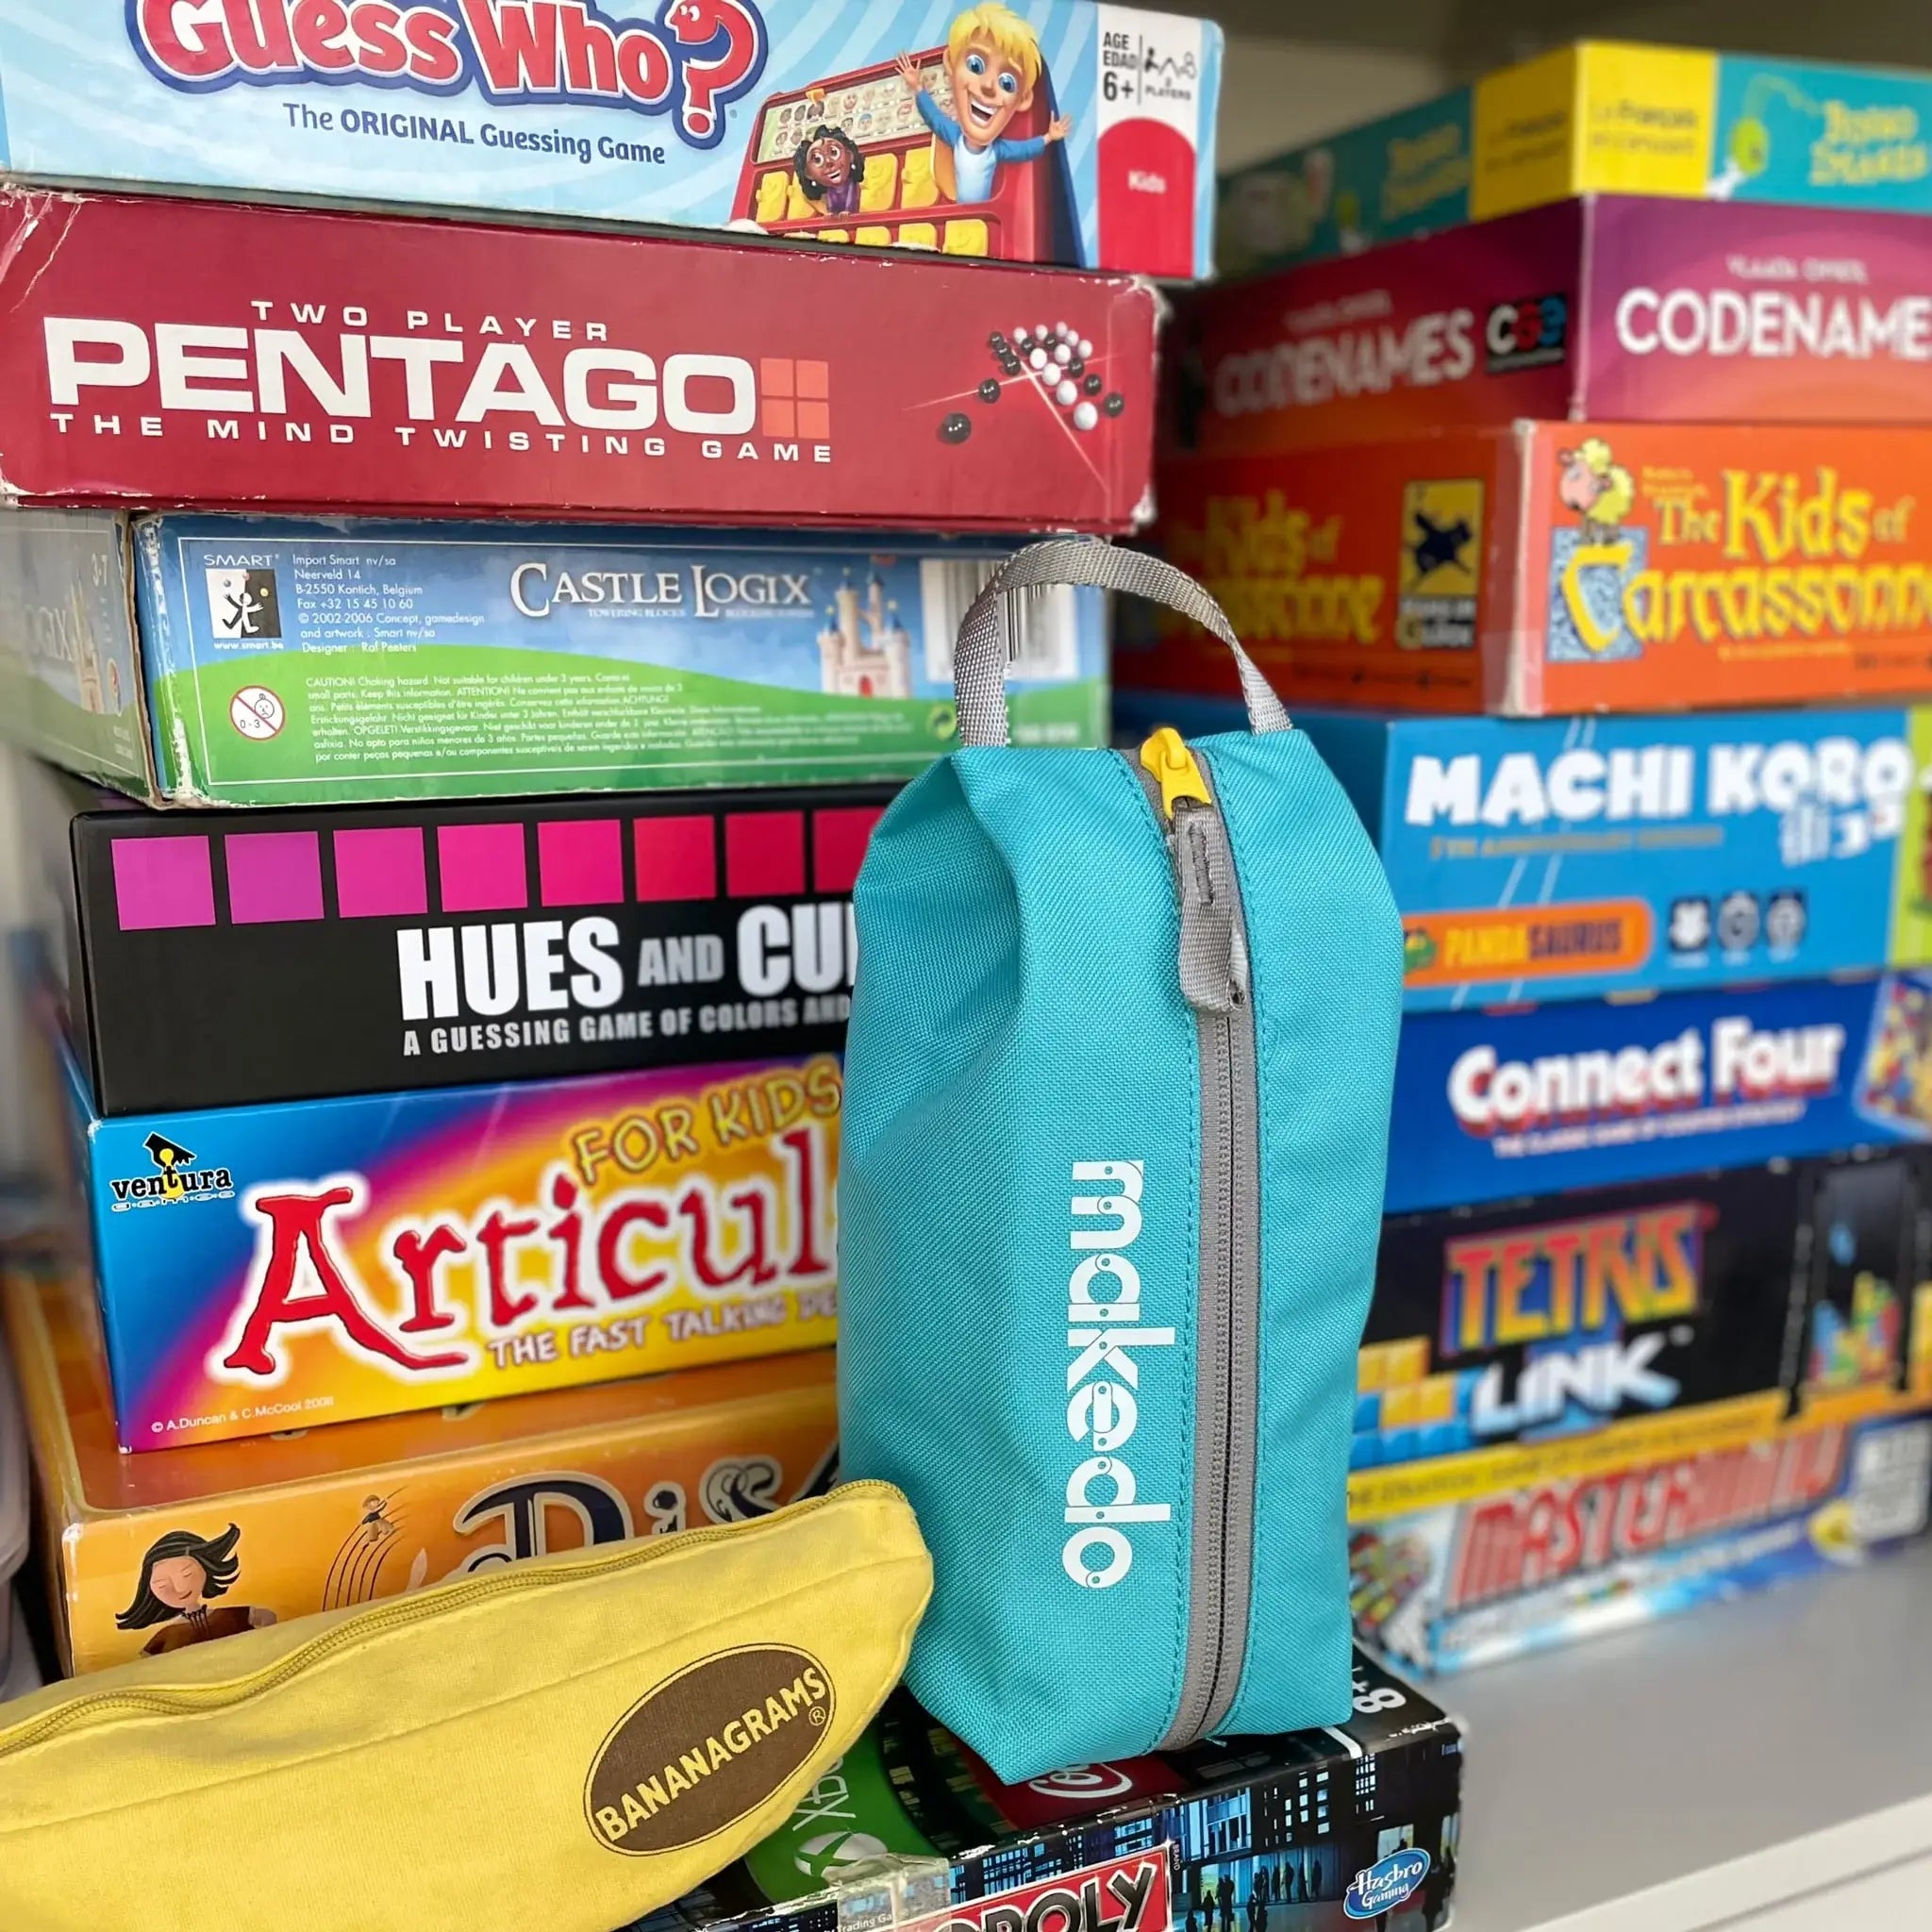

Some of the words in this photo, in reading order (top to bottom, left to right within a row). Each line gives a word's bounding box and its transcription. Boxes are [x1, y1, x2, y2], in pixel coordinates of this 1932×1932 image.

[135, 0, 462, 85] Guess
[1103, 32, 1130, 50] AGE
[1103, 50, 1139, 70] EDAD
[1103, 71, 1135, 102] 6+
[283, 103, 333, 130] The
[340, 109, 474, 145] ORIGINAL
[480, 123, 591, 164] Guessing
[598, 135, 665, 165] Game
[252, 300, 367, 328] TWO
[408, 309, 609, 342] PLAYER
[1616, 287, 1932, 360] CODENAME
[43, 316, 758, 436] PENTAGO
[50, 413, 163, 439] THE
[208, 418, 356, 445] MIND
[396, 426, 665, 457] TWISTING
[702, 439, 831, 463] GAME
[1722, 465, 1874, 561] Kids
[203, 554, 274, 567] SMART
[292, 554, 326, 568] Import
[329, 554, 359, 566] Smart
[366, 555, 396, 567] nv/sa
[294, 568, 343, 580] Neerveld
[347, 569, 361, 580] 14
[295, 583, 335, 594] B-2550
[338, 583, 379, 596] Kontich,
[382, 583, 423, 597] Belgium
[297, 598, 317, 609] Fax
[320, 597, 341, 609] +32
[346, 597, 359, 609] 15
[363, 597, 377, 609] 45
[383, 597, 396, 609] 10
[399, 597, 414, 609] 60
[509, 561, 683, 619] CASTLE
[690, 564, 812, 619] LOGIX
[1561, 543, 1932, 652] Carcassonn
[300, 626, 321, 639] and
[325, 626, 364, 639] artwork
[374, 626, 404, 639] Smart
[407, 626, 436, 639] nv/sa
[425, 611, 485, 626] gamedesign
[213, 641, 284, 650] www.smart.be
[302, 641, 347, 657] Designer
[361, 640, 378, 653] Raf
[381, 641, 417, 653] Peeters
[306, 676, 355, 687] CAUTION!
[358, 675, 395, 688] Choking
[434, 675, 450, 685] Not
[453, 674, 485, 685] suitable
[486, 675, 498, 684] for
[308, 690, 331, 700] small
[360, 689, 384, 700] Keep
[386, 689, 401, 699] this
[457, 686, 510, 696] ATTENTION!
[330, 702, 354, 711] Petits
[395, 699, 446, 711] susceptibles
[391, 712, 416, 723] Nicht
[470, 709, 498, 720] Kinder
[348, 739, 364, 748] No
[366, 739, 387, 749] apto
[388, 738, 409, 749] para
[411, 736, 435, 746] niños
[437, 734, 473, 744] menores
[474, 734, 485, 744] de
[521, 732, 546, 742] Partes
[353, 724, 398, 736] OPGELET!
[315, 752, 331, 763] por
[333, 750, 360, 760] conter
[363, 750, 391, 761] peças
[391, 749, 434, 761] pequenas
[435, 746, 458, 758] e/ou
[458, 746, 514, 758] componentes
[563, 742, 575, 753] de
[1404, 744, 1697, 826] MACHI
[1706, 736, 1916, 815] KORO
[396, 916, 625, 1022] HUES
[638, 934, 725, 988] AND
[403, 1030, 422, 1057] A
[431, 1018, 571, 1056] GUESSING
[580, 1010, 654, 1043] GAME
[660, 1007, 693, 1036] OF
[698, 997, 798, 1033] COLORS
[803, 994, 851, 1024] AND
[1447, 1024, 1704, 1127] Connect
[1711, 1017, 1846, 1097] Four
[574, 1107, 701, 1188] FOR
[709, 1061, 841, 1159] KIDS
[110, 1165, 234, 1200] ventura
[223, 1129, 834, 1374] Articul
[1447, 1208, 1697, 1350] TETRIS
[486, 1334, 557, 1370] THE
[570, 1321, 654, 1357] FAST
[666, 1300, 790, 1342] TALKING
[797, 1292, 839, 1322] DE
[1062, 1159, 1176, 1590] makedo
[1471, 1333, 1682, 1436] LINK
[166, 1413, 226, 1432] A.Duncan
[241, 1401, 303, 1420] C.McCool
[595, 1667, 826, 1842] BANANAGRAMS
[1350, 1861, 1424, 1896] Hasbro
[1361, 1883, 1409, 1910] Gaming
